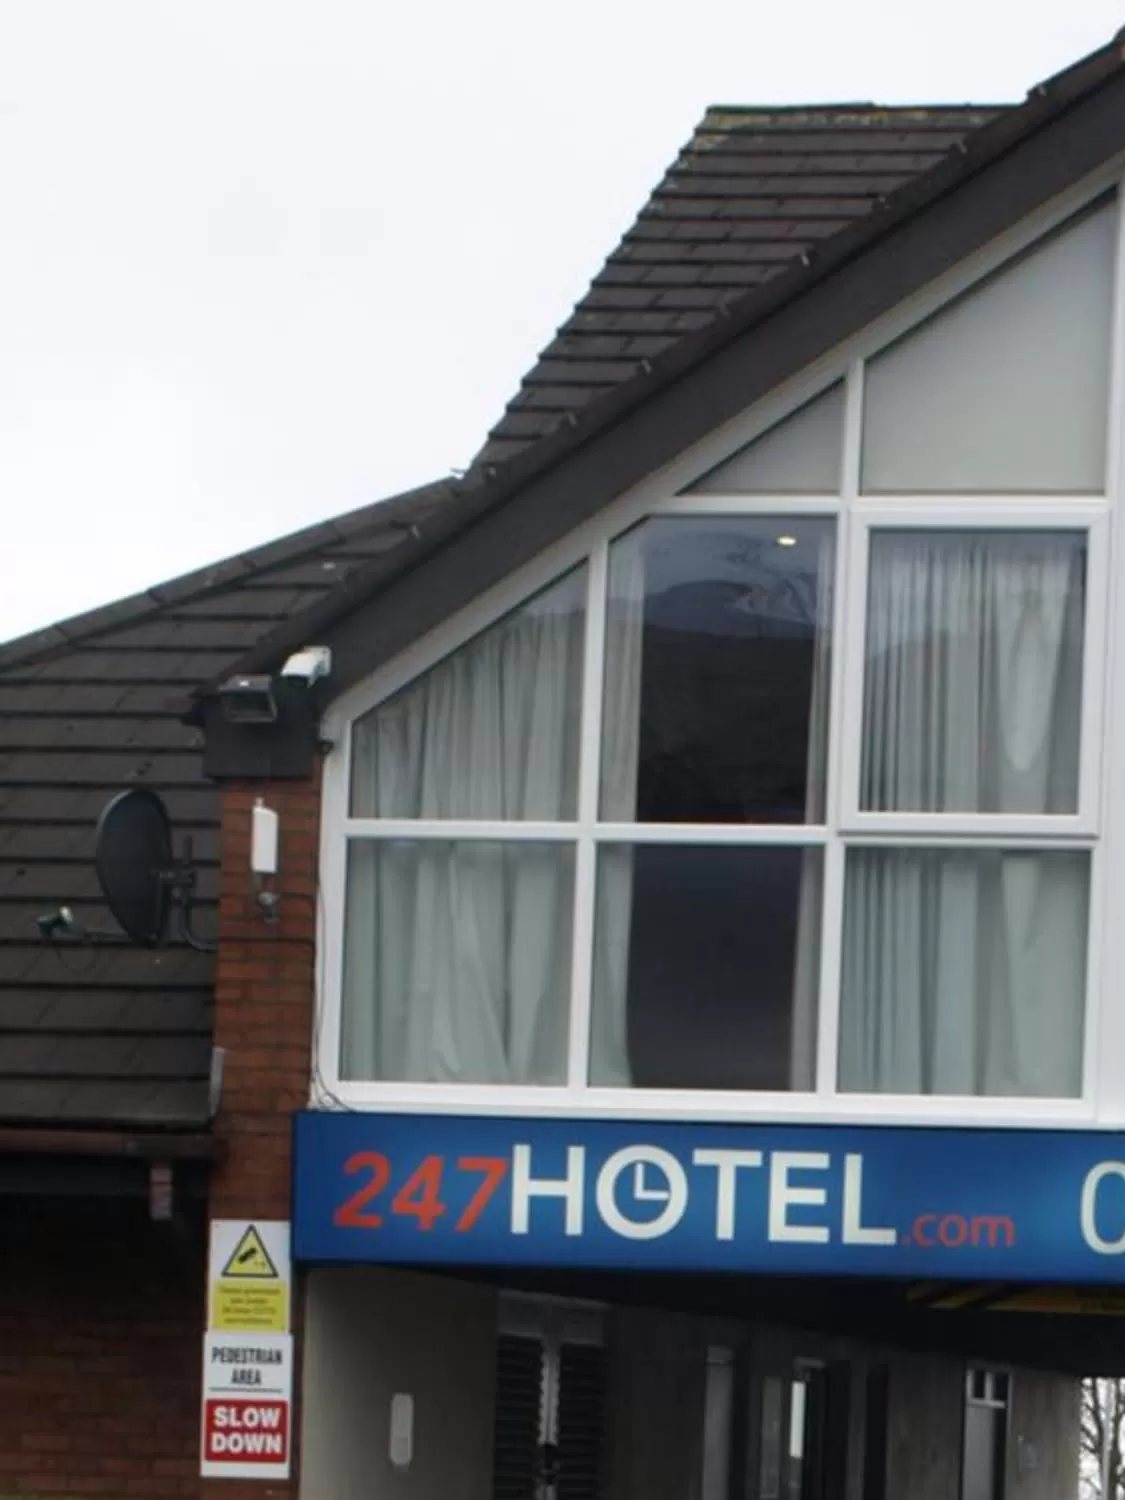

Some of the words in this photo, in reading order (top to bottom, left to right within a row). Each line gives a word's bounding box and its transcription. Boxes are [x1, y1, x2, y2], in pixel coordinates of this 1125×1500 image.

[211, 1346, 283, 1365] PEDESTRIAN
[230, 1368, 262, 1386] AREA
[213, 1406, 281, 1428] SLOW
[210, 1432, 282, 1455] DOWN
